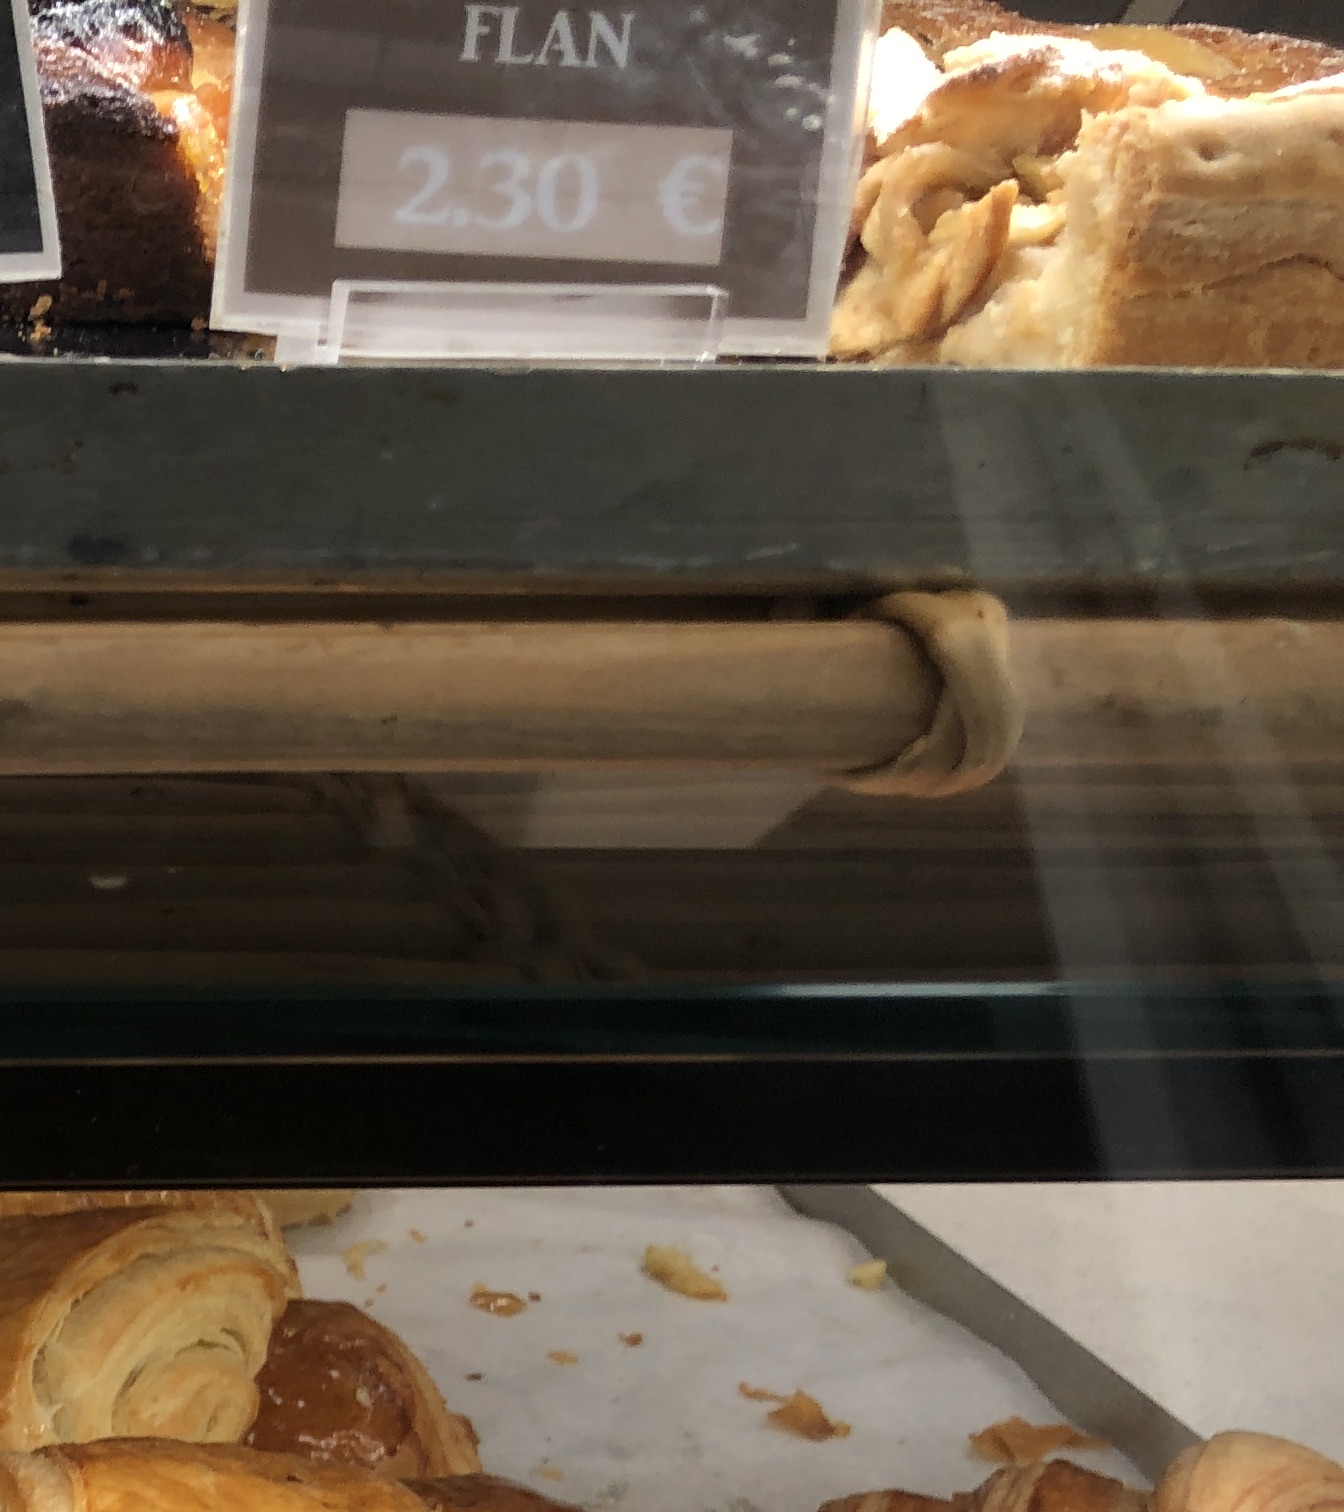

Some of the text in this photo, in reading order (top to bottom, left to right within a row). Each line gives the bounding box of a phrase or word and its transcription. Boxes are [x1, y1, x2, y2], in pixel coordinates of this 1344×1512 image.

[458, 4, 639, 71] FLAN
[392, 143, 726, 236] 2.30 €
